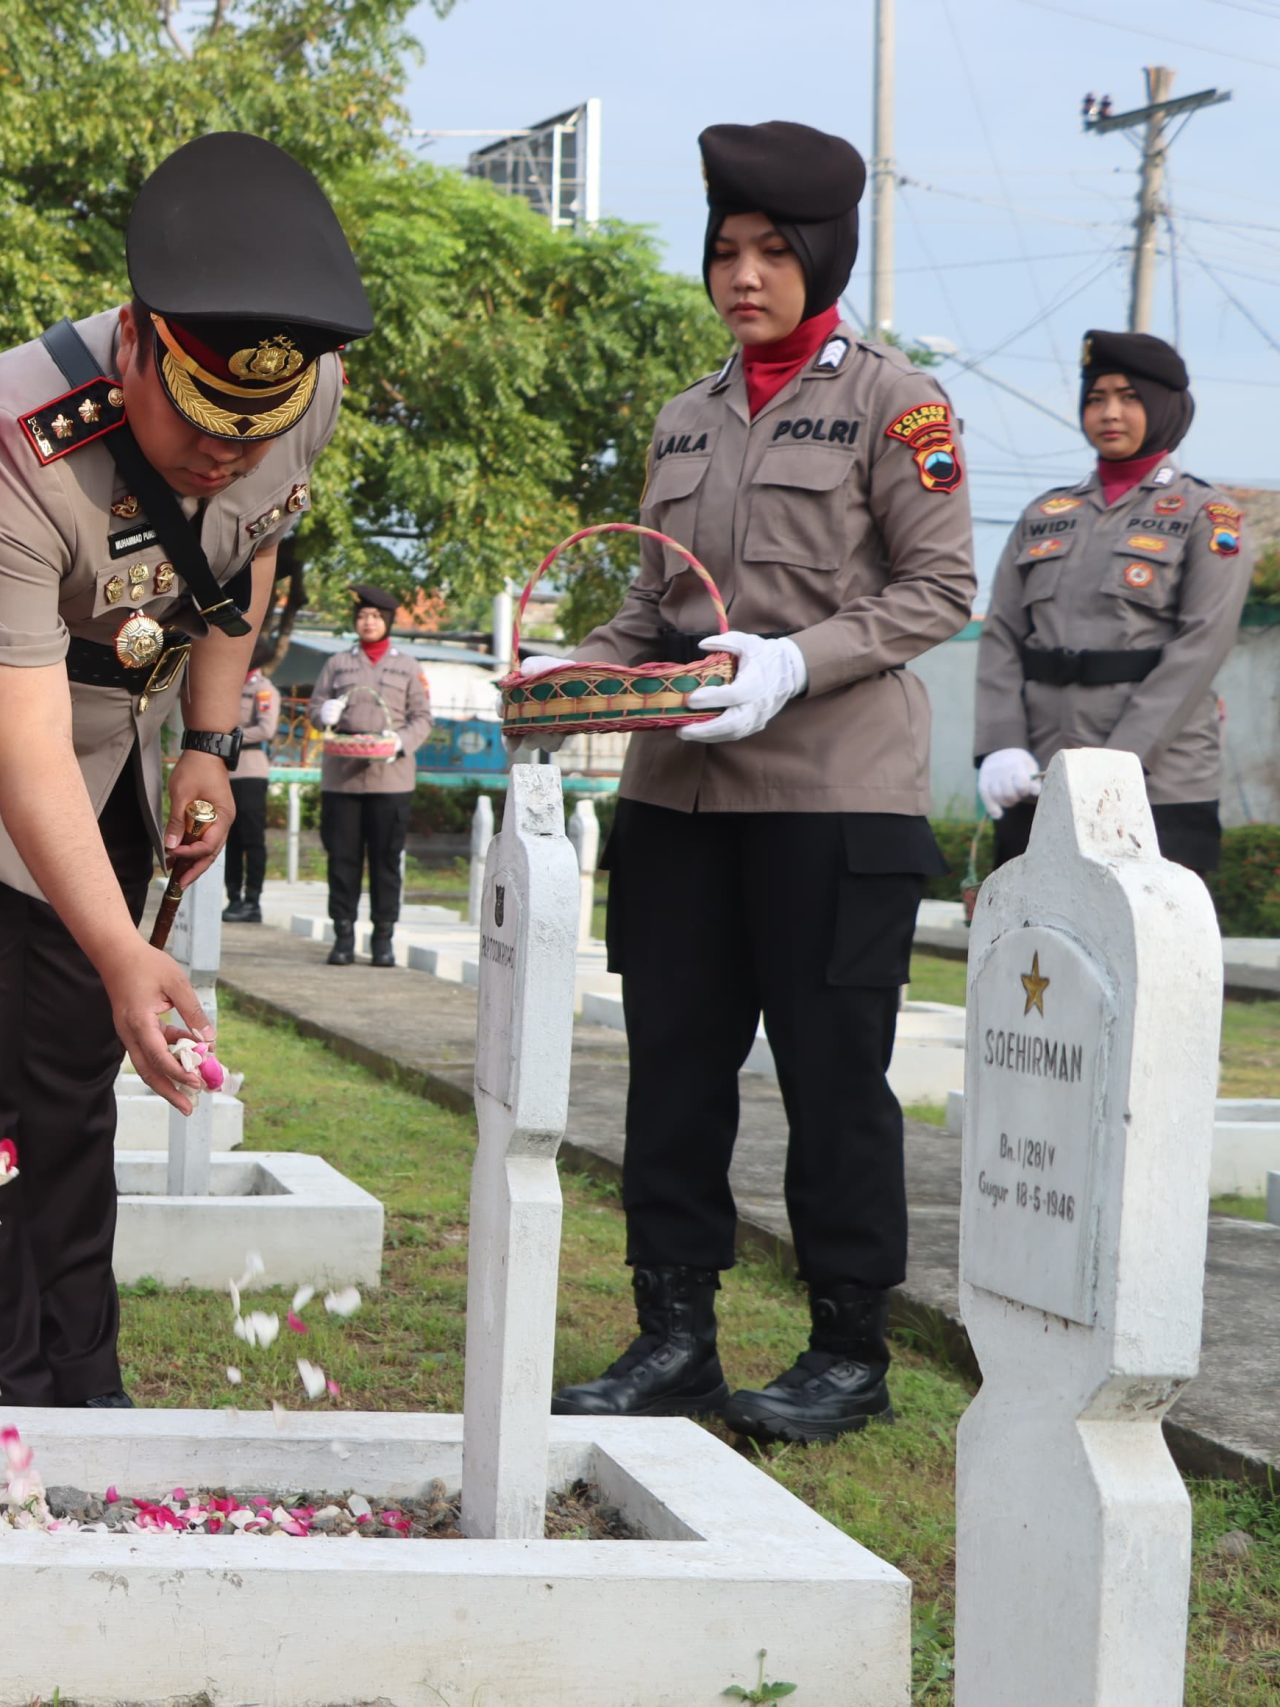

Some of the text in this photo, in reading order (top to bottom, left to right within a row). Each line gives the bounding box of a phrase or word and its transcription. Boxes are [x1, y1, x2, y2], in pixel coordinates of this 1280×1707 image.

[772, 417, 860, 446] POLRI
[892, 405, 946, 434] POLRES
[902, 414, 946, 437] DEMAK
[656, 432, 708, 461] LAILA
[1029, 518, 1078, 538] WIDI
[1126, 517, 1189, 535] POLRI
[114, 533, 142, 551] MUHAMMAD
[984, 1028, 1083, 1083] SOEHIRMAN
[978, 1170, 1075, 1223] Gugur 18-5-1946
